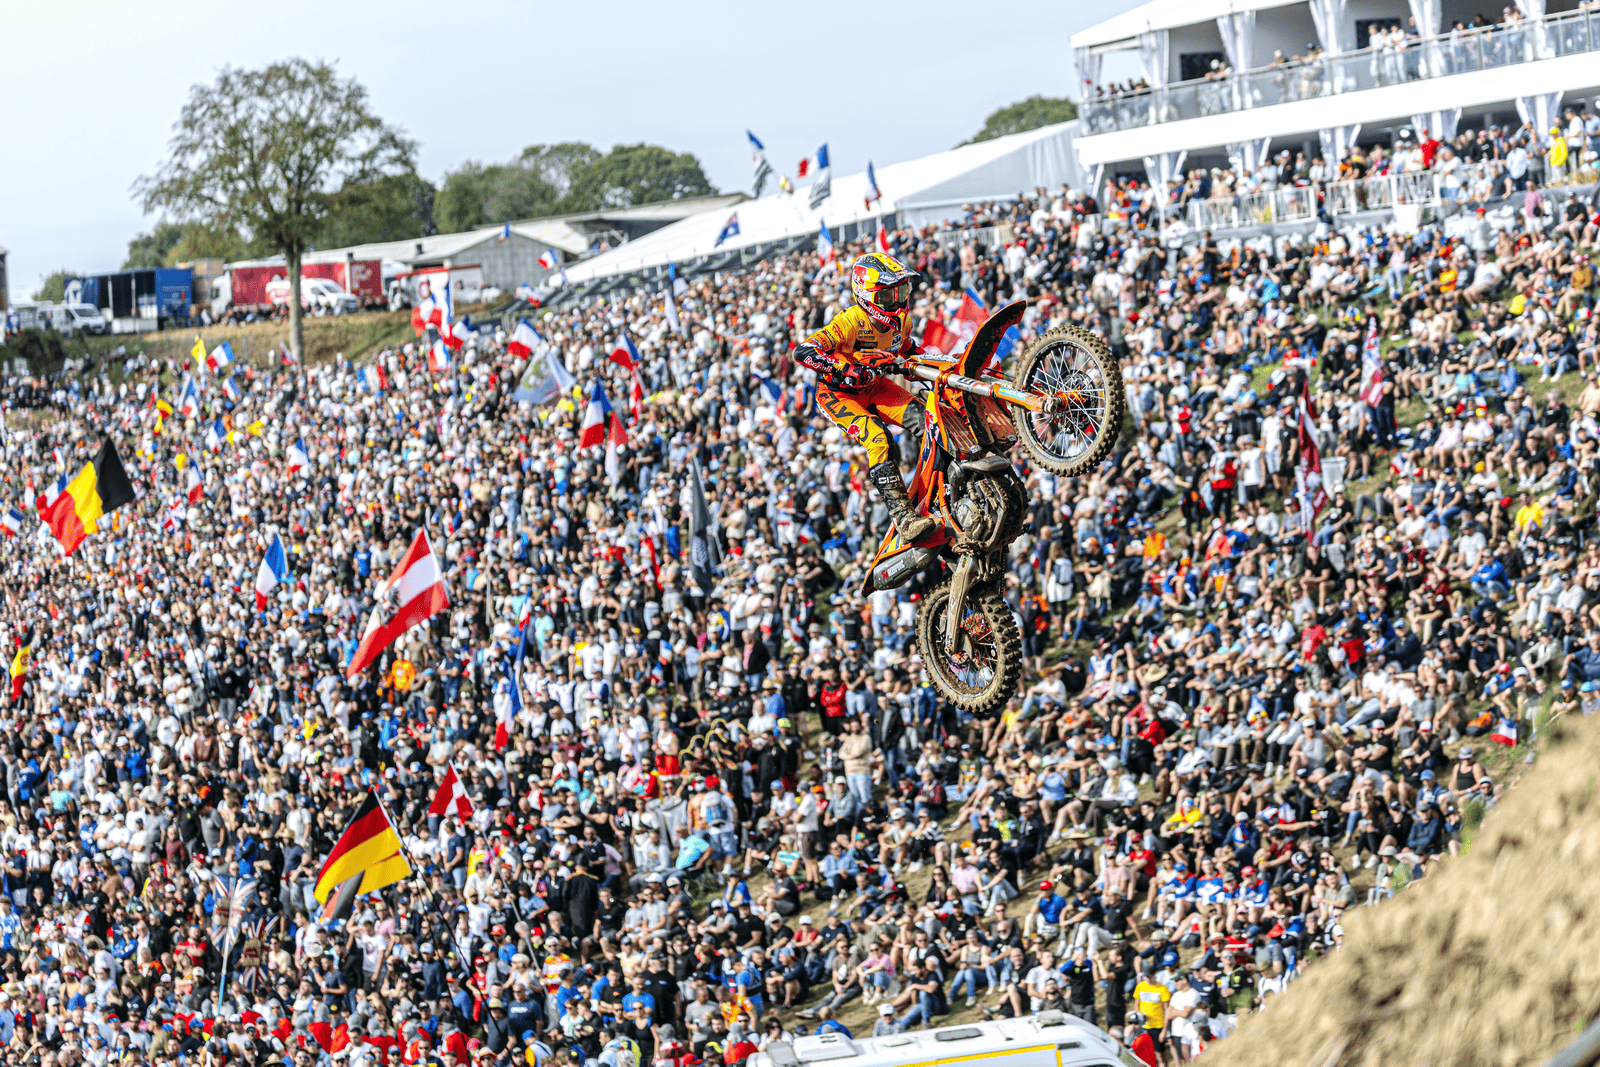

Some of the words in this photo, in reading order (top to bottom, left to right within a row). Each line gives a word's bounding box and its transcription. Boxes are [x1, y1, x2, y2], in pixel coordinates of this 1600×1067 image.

[803, 355, 819, 368] Red
[819, 392, 854, 418] FLY
[878, 475, 900, 484] SIDI
